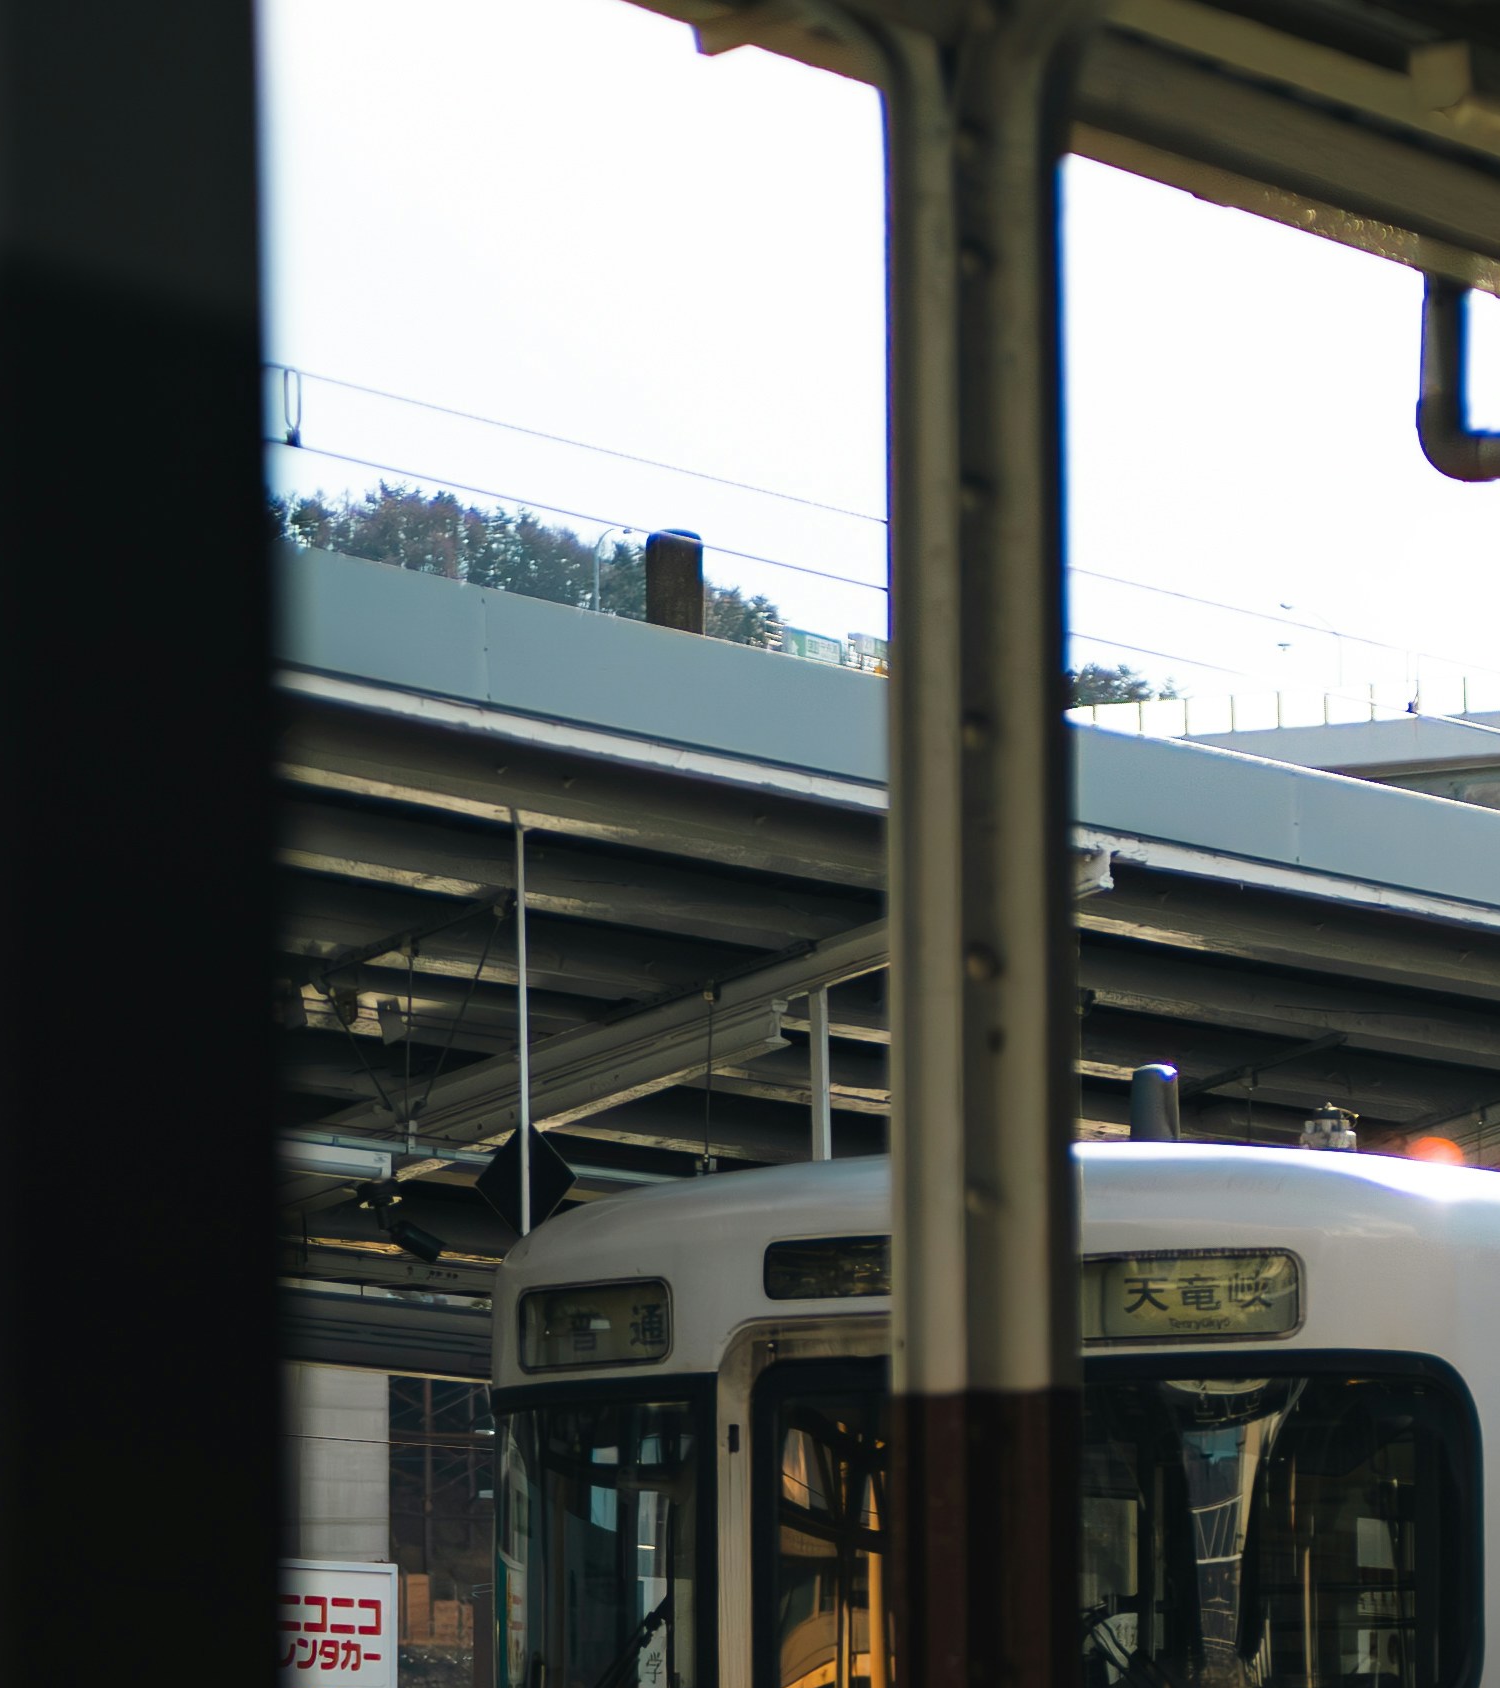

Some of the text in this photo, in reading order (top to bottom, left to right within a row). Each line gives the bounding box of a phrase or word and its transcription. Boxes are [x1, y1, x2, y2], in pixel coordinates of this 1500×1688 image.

[1124, 1270, 1273, 1314] 天竜峡
[277, 1594, 382, 1636] ニコニコ
